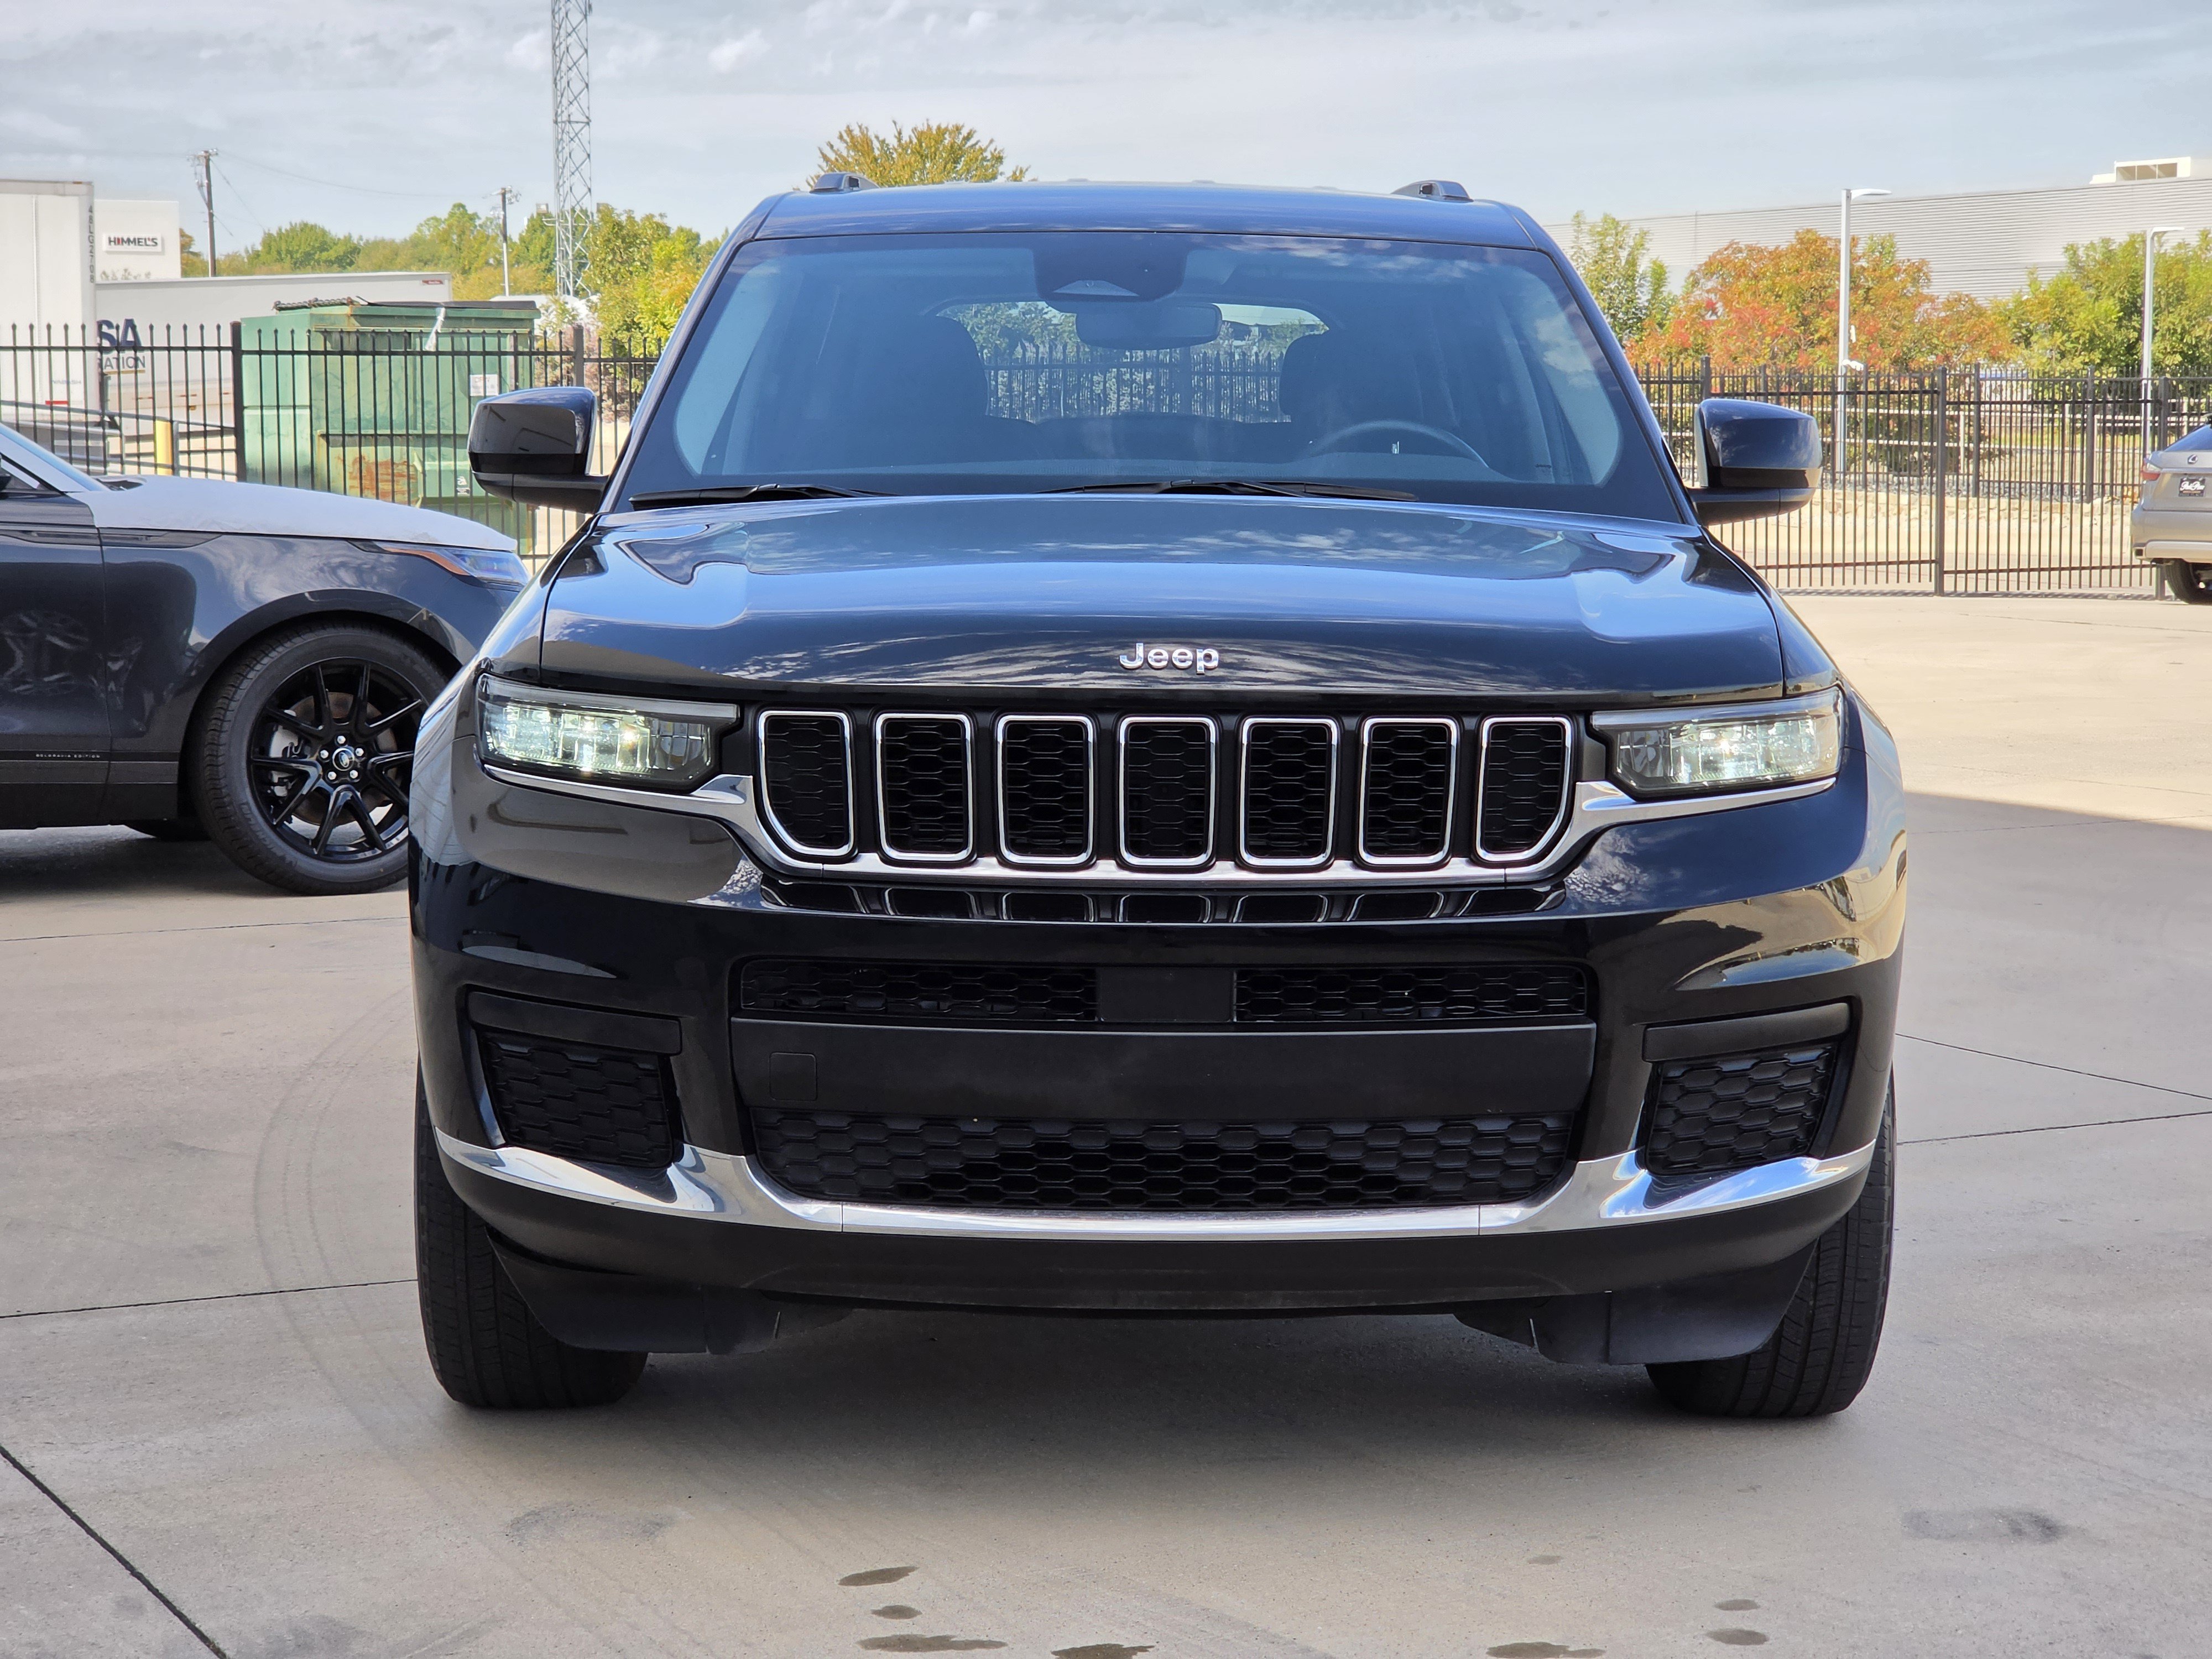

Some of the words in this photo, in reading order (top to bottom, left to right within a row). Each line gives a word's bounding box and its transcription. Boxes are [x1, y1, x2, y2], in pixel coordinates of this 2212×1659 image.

[108, 237, 158, 247] HIMMEL'S
[98, 356, 146, 370] ATION
[1119, 643, 1219, 675] Jeep
